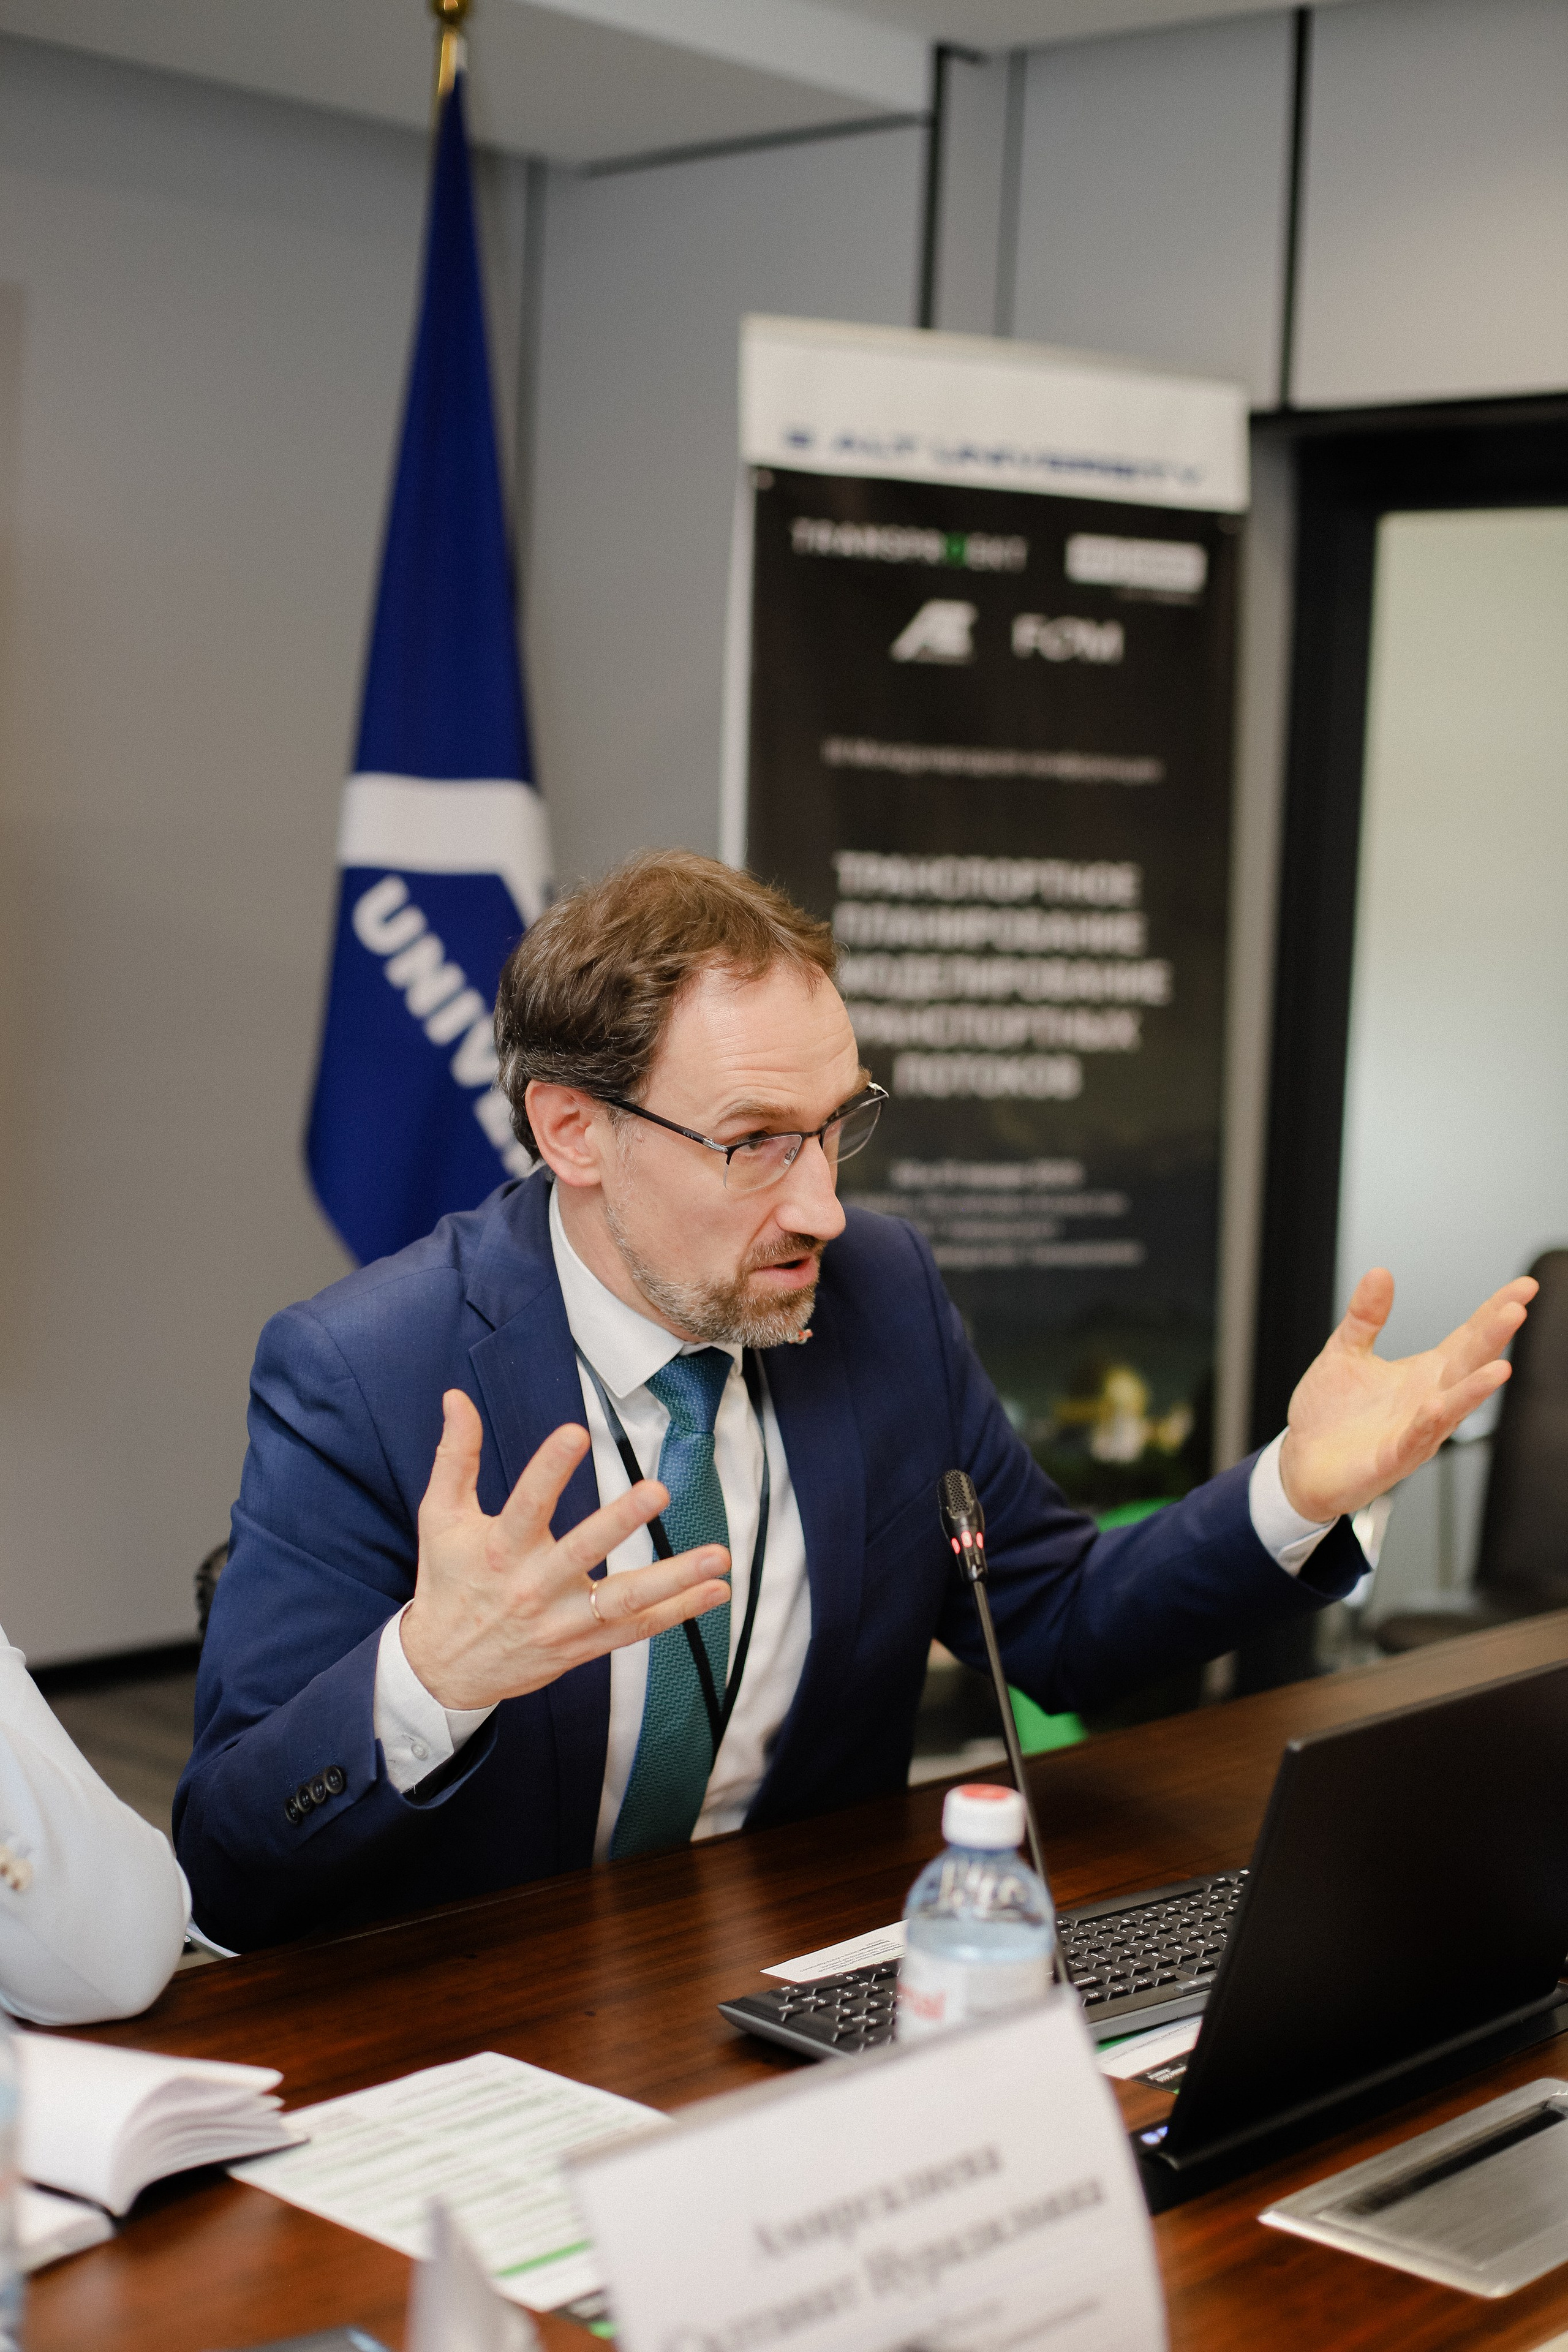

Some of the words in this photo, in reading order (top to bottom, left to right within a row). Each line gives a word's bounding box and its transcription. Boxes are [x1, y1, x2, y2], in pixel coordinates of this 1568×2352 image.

[835, 851, 1142, 908] ТРАНСПОРТНОЕ
[848, 1003, 1143, 1053] РАНСПОРТНЫХ
[892, 1052, 1084, 1099] ПОТОКОВ
